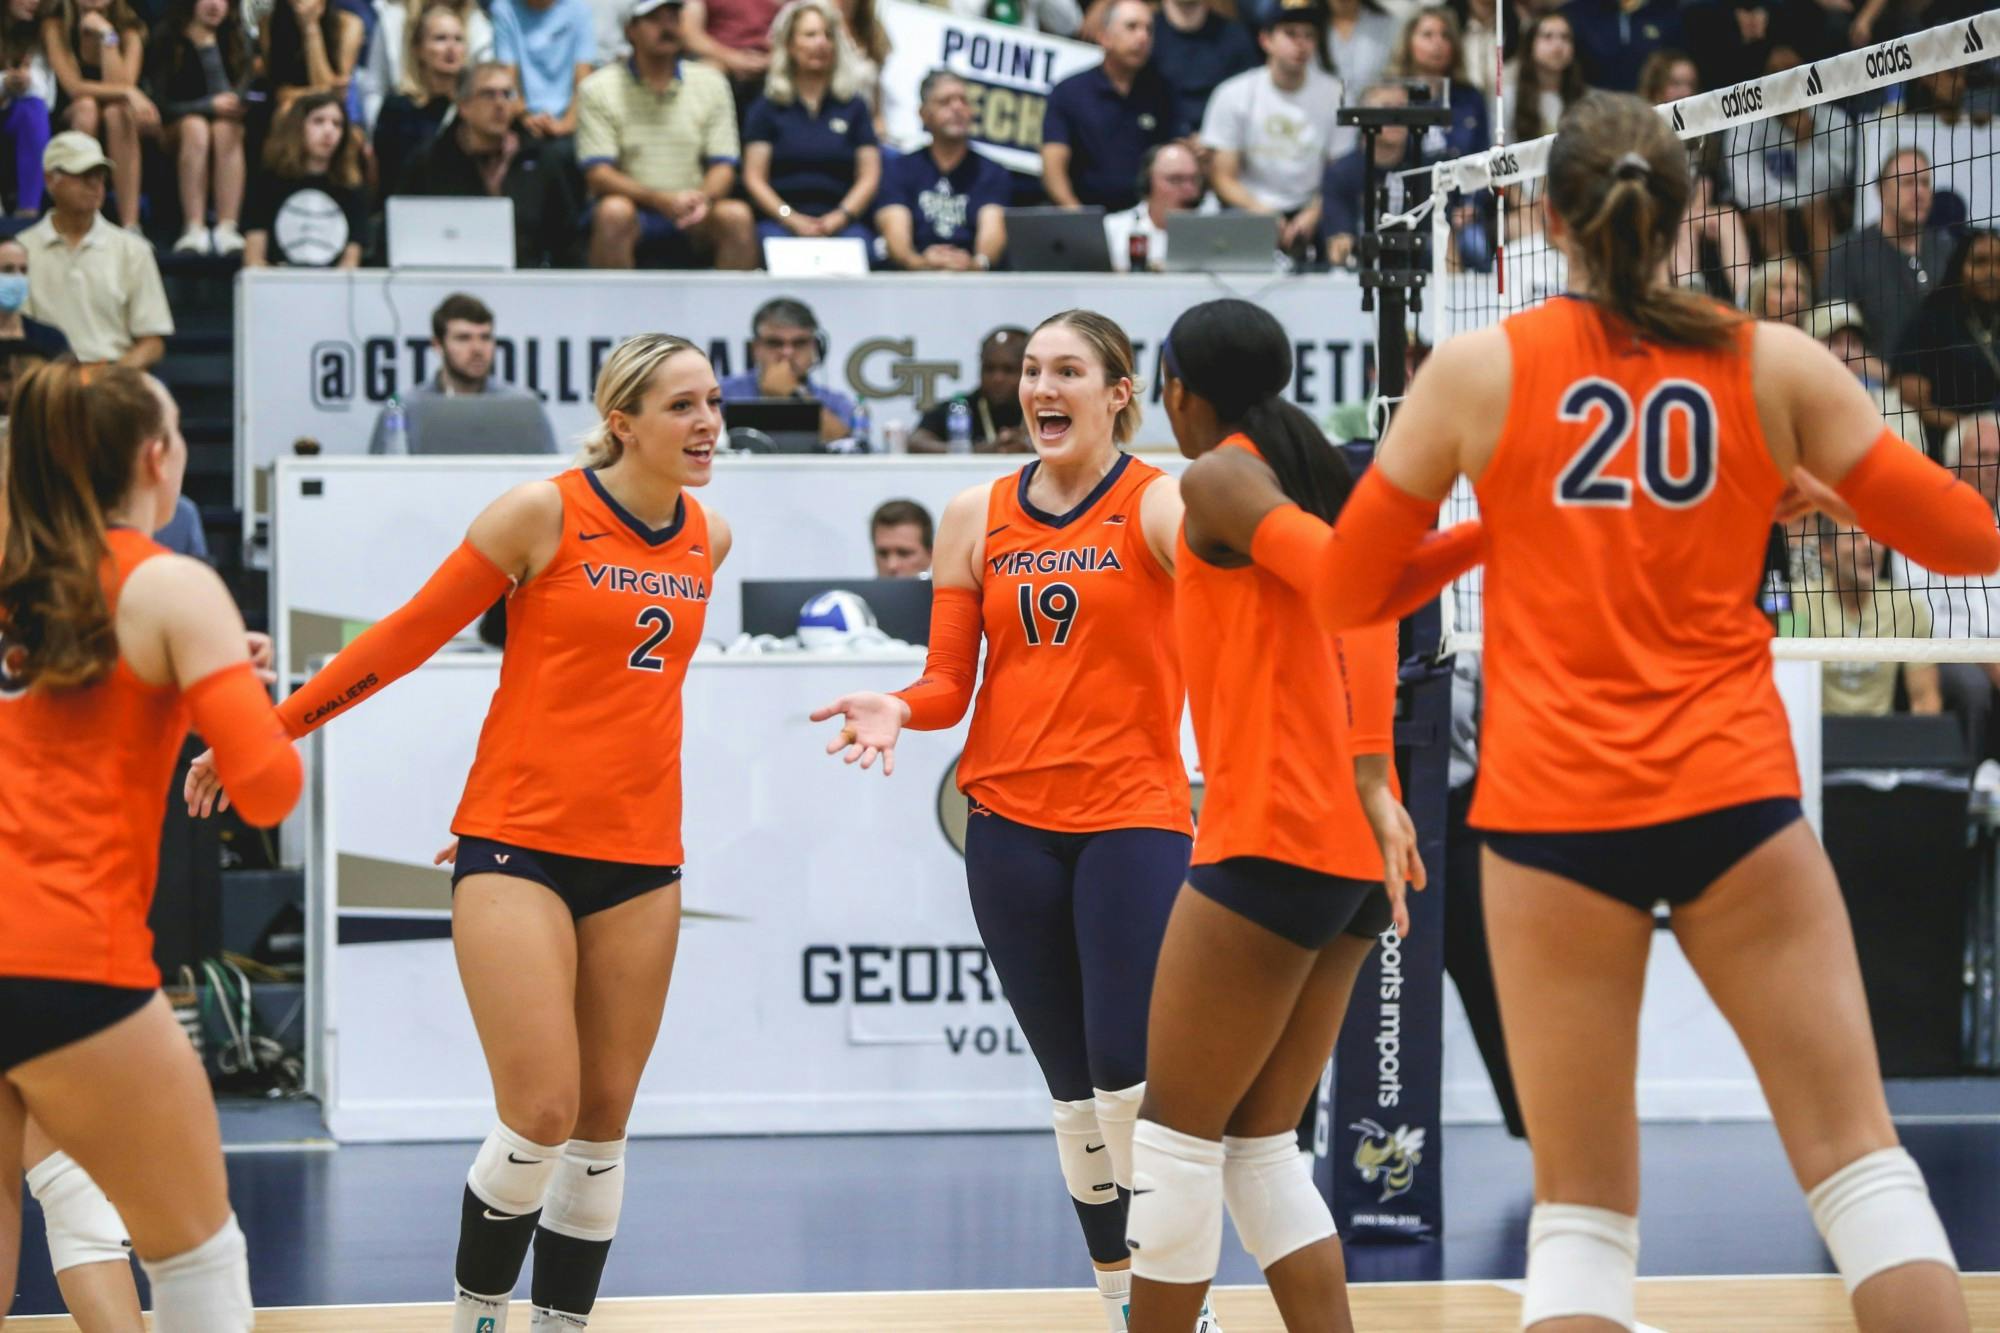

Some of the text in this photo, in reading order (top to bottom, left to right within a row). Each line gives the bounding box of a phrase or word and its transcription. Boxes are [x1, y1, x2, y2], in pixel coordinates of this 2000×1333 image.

[944, 30, 1056, 84] POINT
[1866, 41, 1913, 79] adidas
[967, 83, 1047, 147] ECH
[1721, 82, 1763, 119] adidas
[845, 336, 960, 412] GT
[1553, 375, 1719, 510] 20
[582, 561, 709, 602] VIRGINIA
[989, 546, 1123, 576] VIRGINIA
[627, 605, 674, 672] 2
[1018, 582, 1079, 645] 19
[304, 672, 379, 724] CAVALIERS
[803, 945, 998, 1004] GEOR
[944, 1025, 1024, 1055] VOL
[1374, 1003, 1403, 1108] imports
